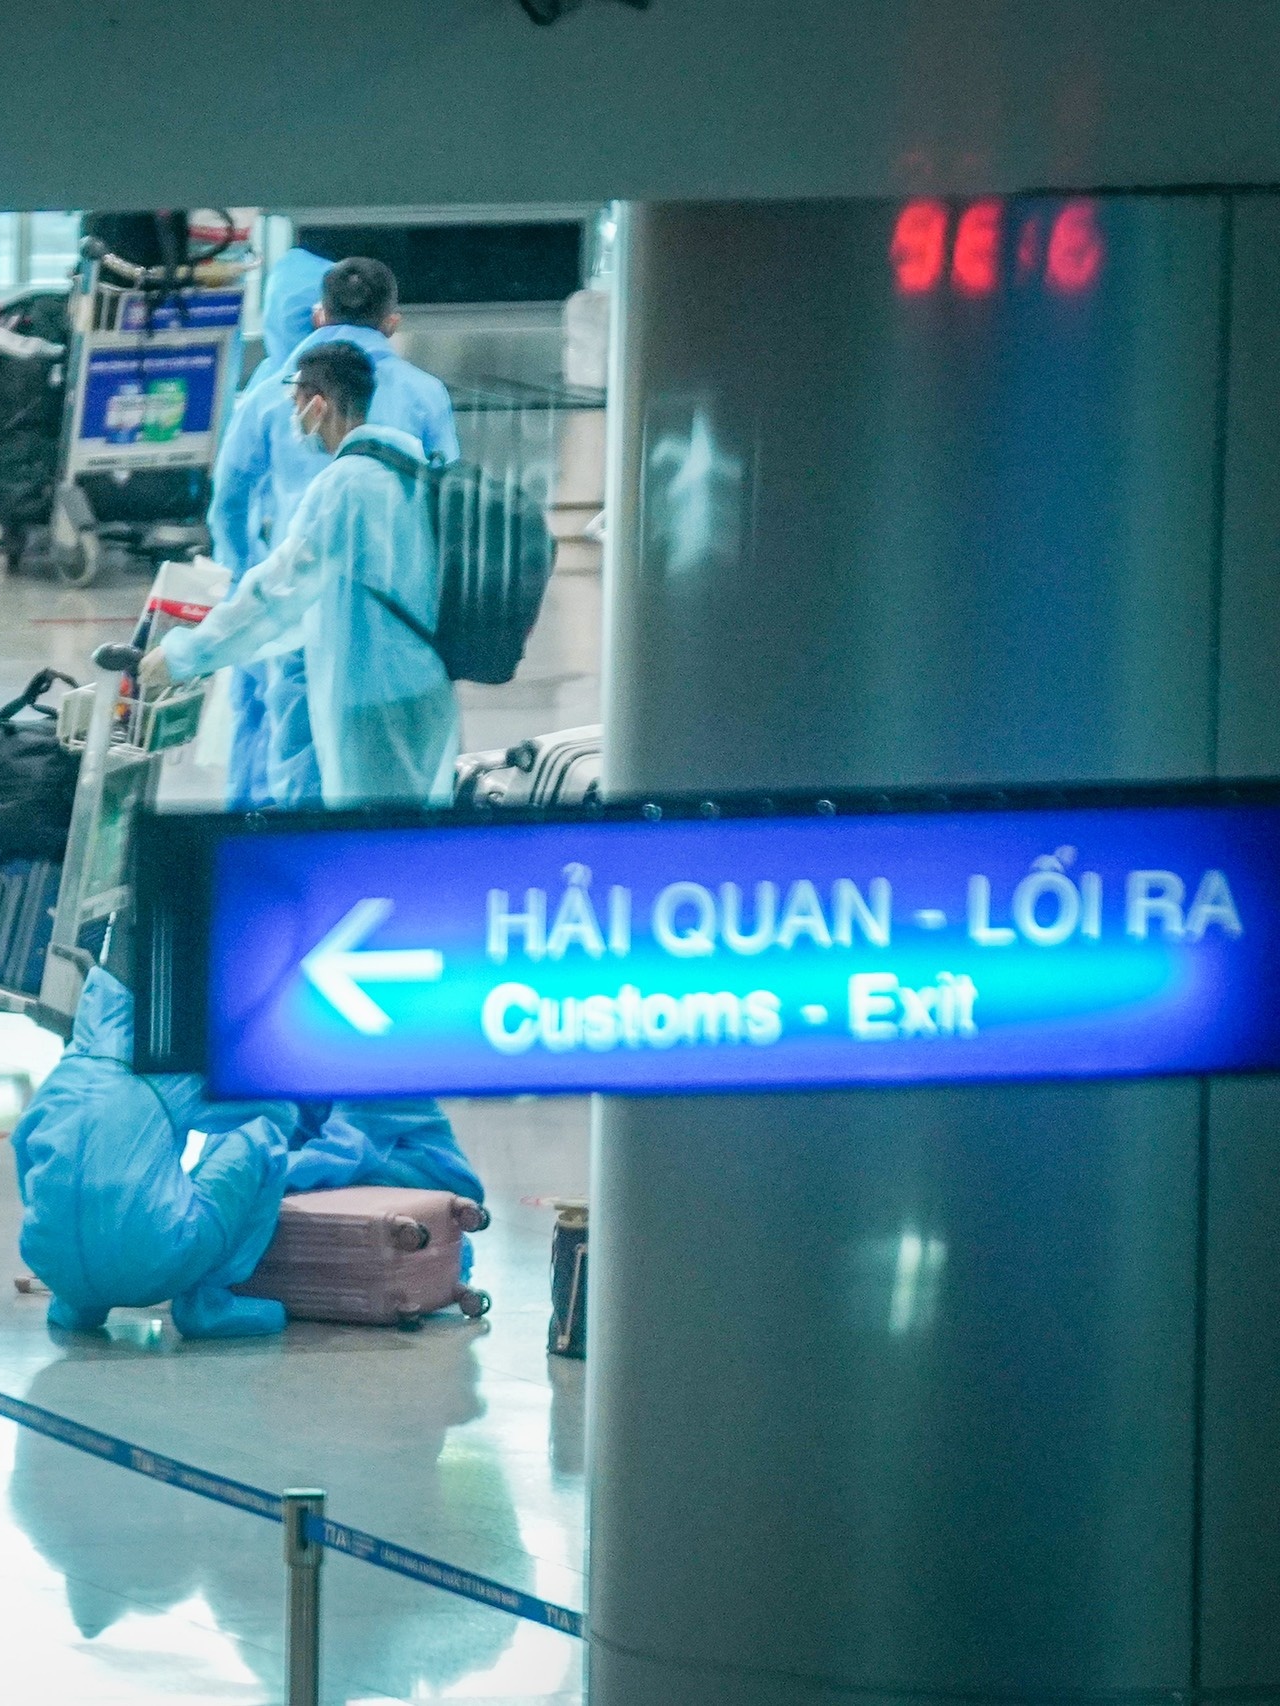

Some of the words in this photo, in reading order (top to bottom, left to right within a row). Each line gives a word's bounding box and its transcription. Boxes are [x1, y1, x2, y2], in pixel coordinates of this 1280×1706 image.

[486, 862, 630, 962] HẢI
[653, 876, 891, 957] QUAN
[914, 908, 946, 929] -
[1125, 869, 1242, 941] RA
[483, 981, 782, 1054] Customs
[848, 970, 978, 1040] Exit
